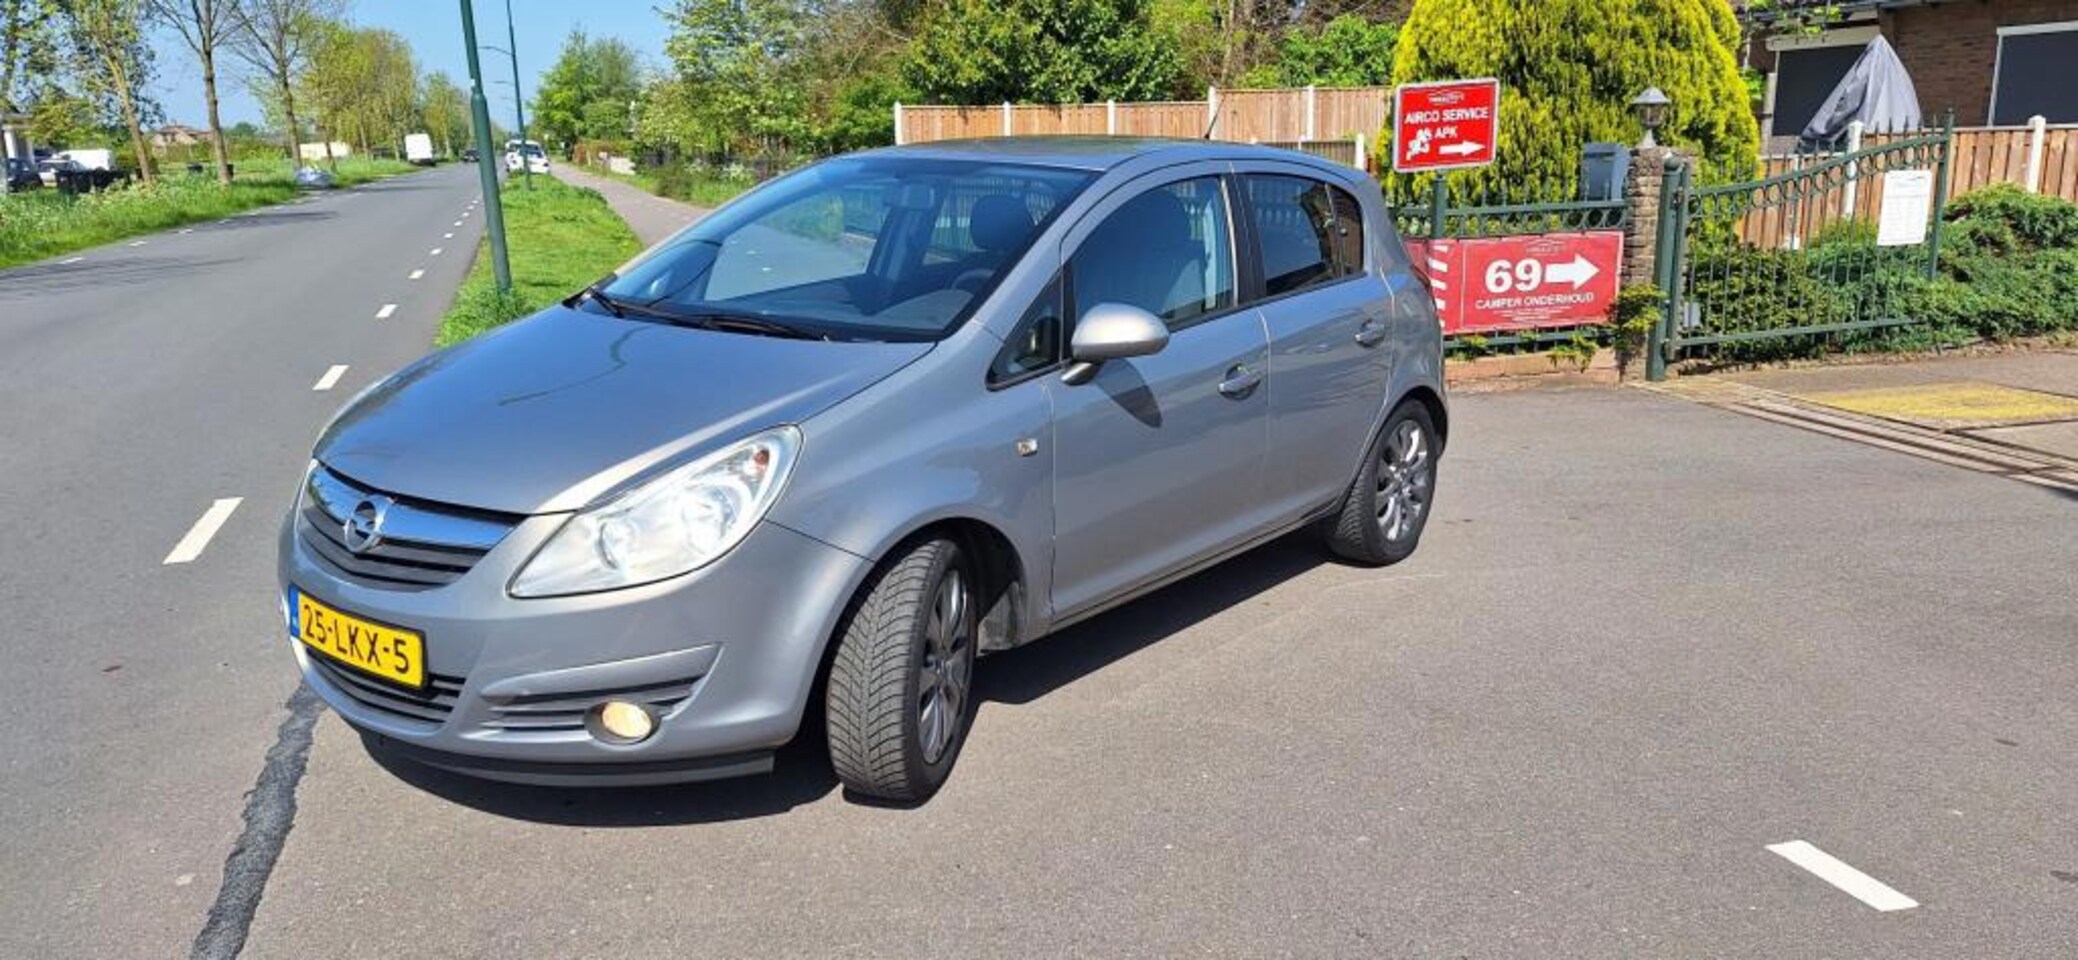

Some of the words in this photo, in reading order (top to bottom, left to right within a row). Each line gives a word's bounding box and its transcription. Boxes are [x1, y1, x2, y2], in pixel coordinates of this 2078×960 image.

[1404, 110, 1440, 124] AIRCO
[1442, 106, 1489, 122] SERVICE
[1434, 126, 1458, 139] APK
[1485, 258, 1542, 293] 69
[1475, 297, 1522, 309] CAMPER
[1524, 292, 1594, 306] ONDERHOUD
[303, 604, 410, 674] 25-LKX-5
